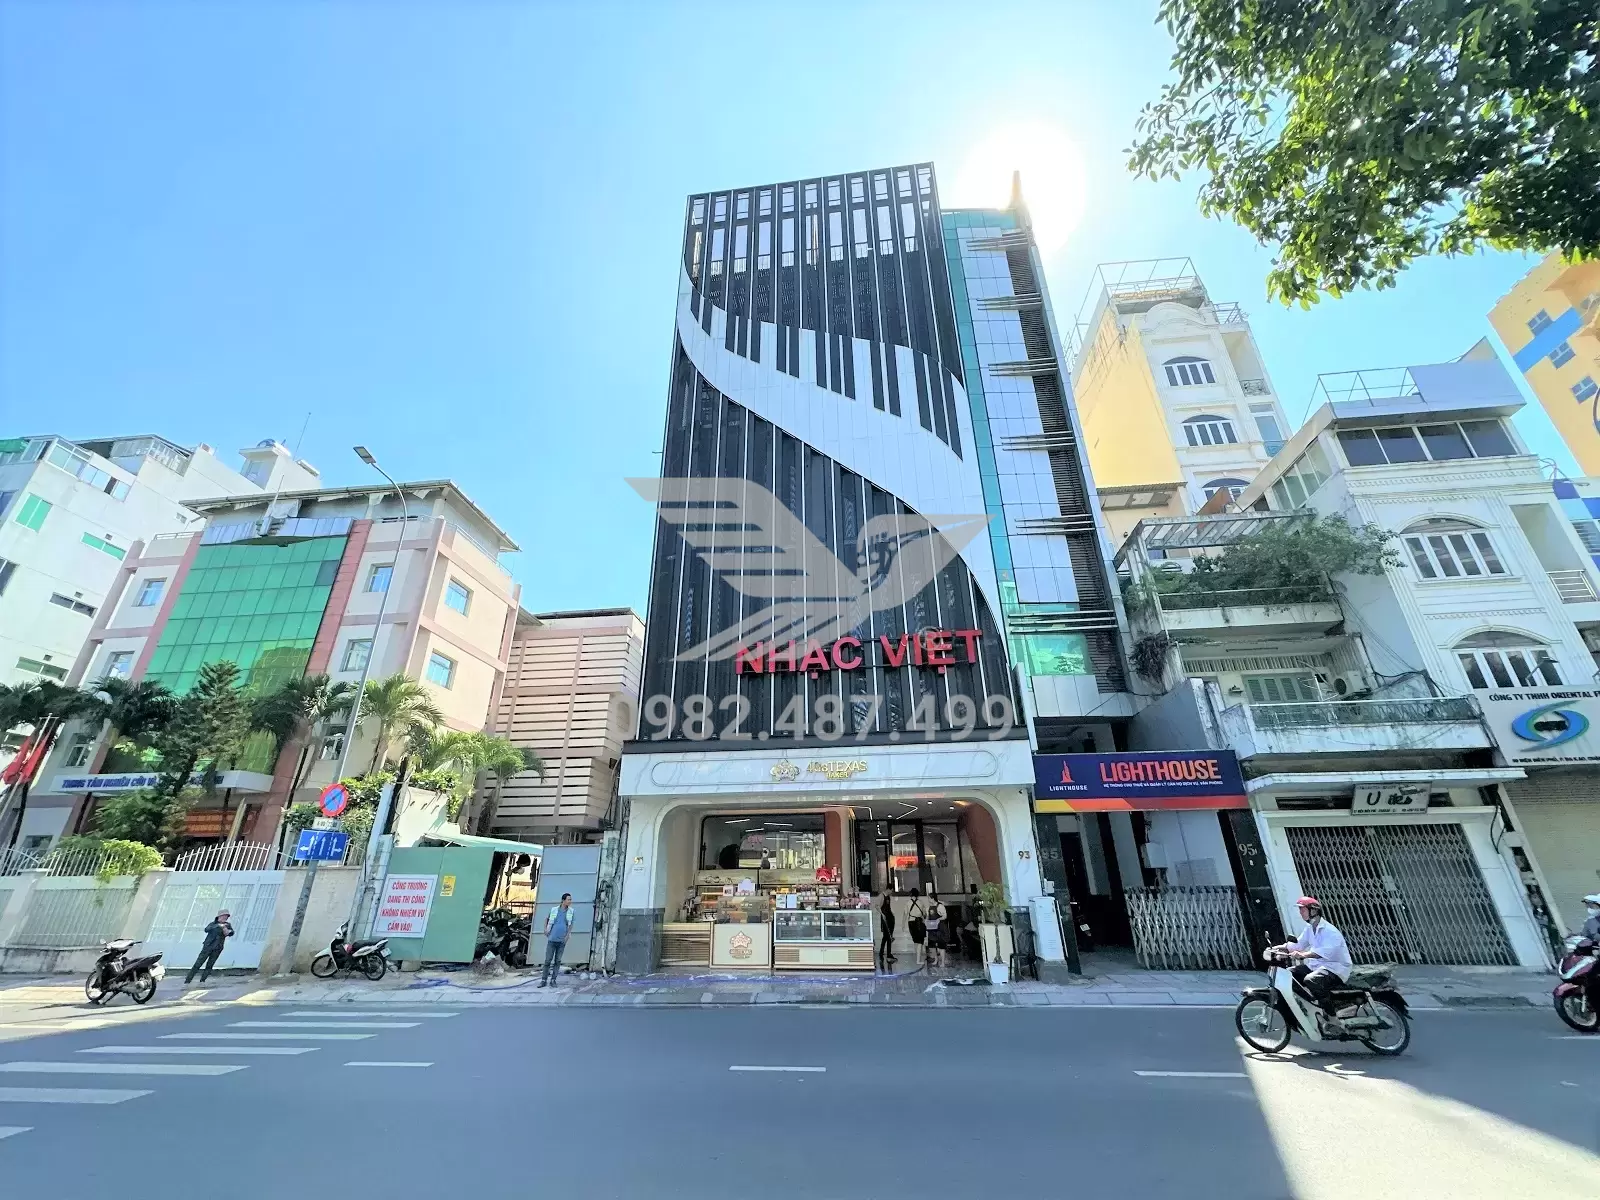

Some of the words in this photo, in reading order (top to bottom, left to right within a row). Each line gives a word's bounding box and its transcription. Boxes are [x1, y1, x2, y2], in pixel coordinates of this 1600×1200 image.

[735, 636, 863, 680] NHẠC
[1489, 692, 1512, 703] CÔNG
[1512, 693, 1524, 702] TY
[1525, 692, 1550, 701] TNHH
[1551, 690, 1593, 700] ORIENTAL
[1099, 759, 1222, 782] LIGHTHOUSE
[1049, 785, 1088, 793] LIGHTHOUSE
[1017, 850, 1031, 860] 93
